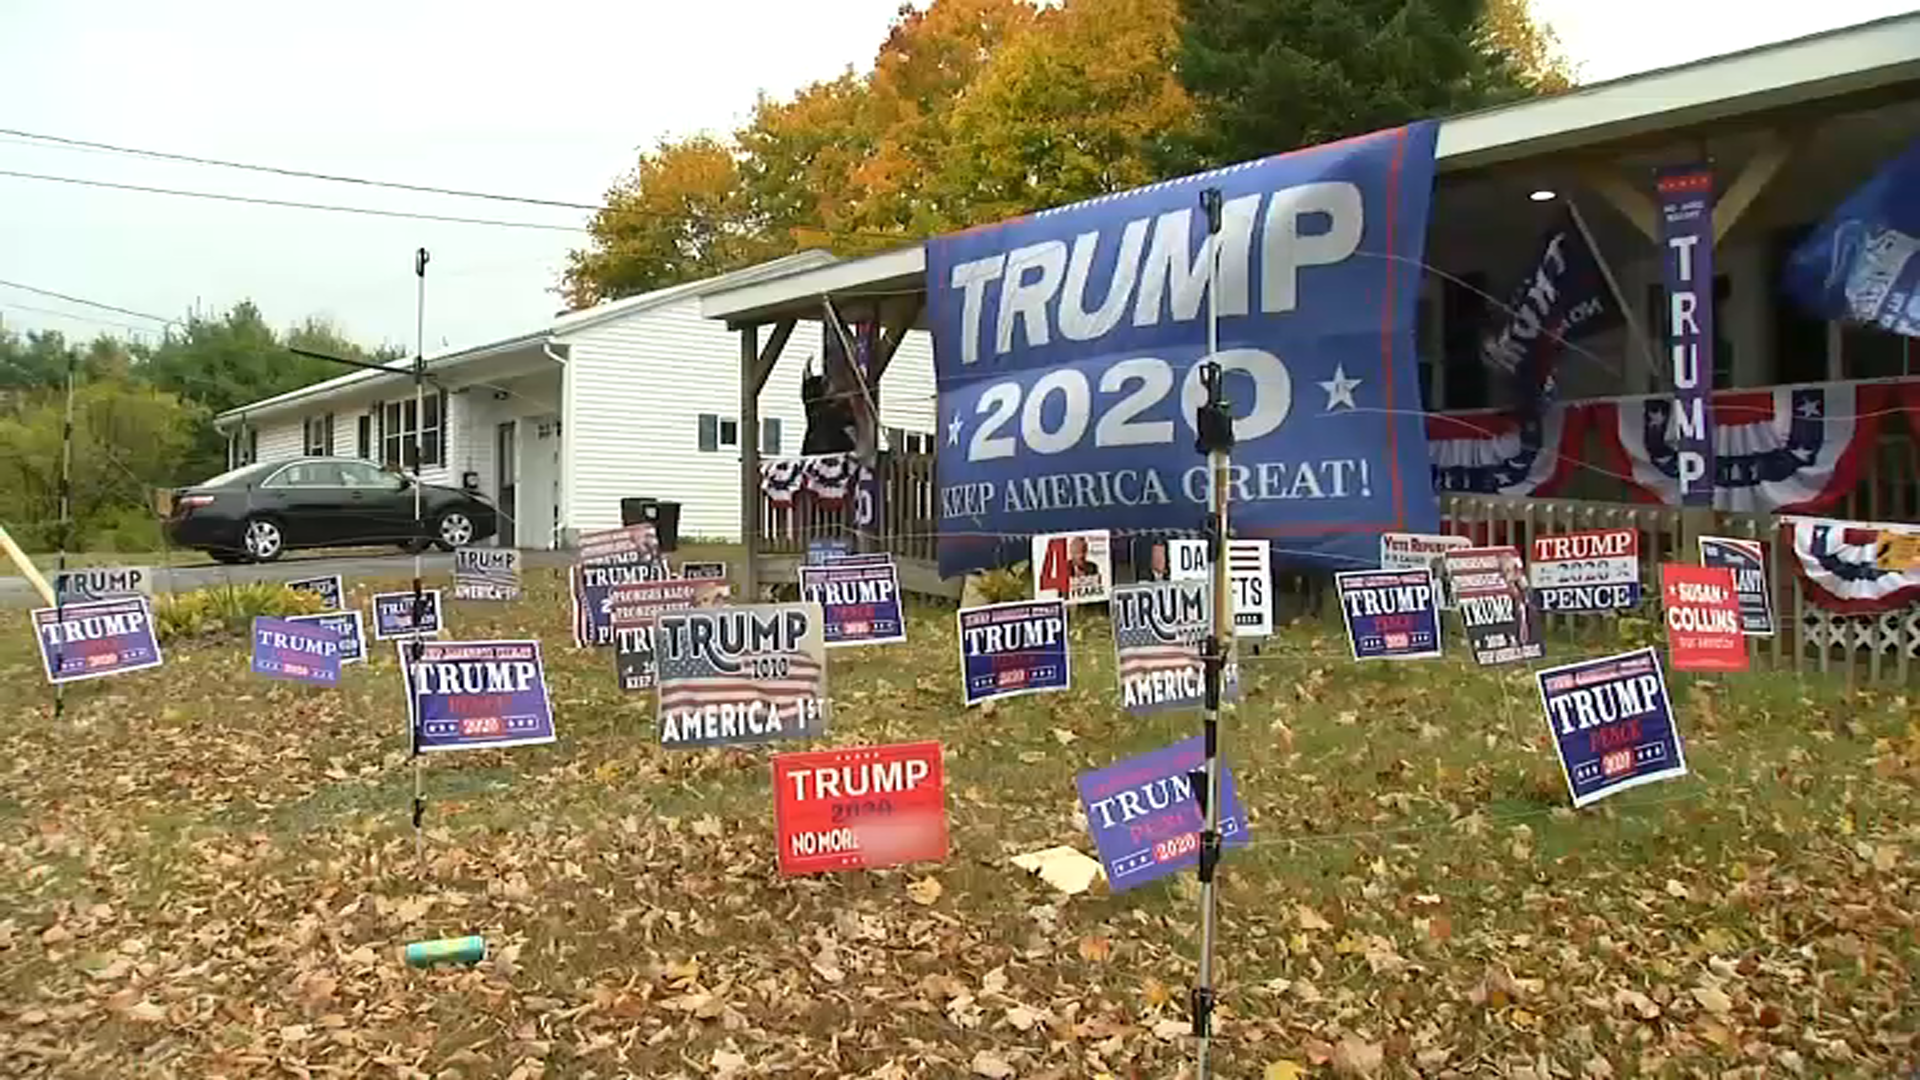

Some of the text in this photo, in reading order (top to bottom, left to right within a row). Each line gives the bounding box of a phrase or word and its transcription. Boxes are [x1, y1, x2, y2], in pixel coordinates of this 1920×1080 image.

[950, 181, 1364, 363] TRUMP
[1668, 235, 1705, 496] TRUMP
[967, 348, 1292, 461] 2020
[940, 459, 1373, 519] KEEP AMERICA GREAT!
[1535, 532, 1631, 560] TRUMP
[459, 551, 515, 575] TRUMP
[584, 565, 649, 587] TRUMP
[1040, 538, 1068, 593] 4
[59, 569, 142, 600] TRUMP
[806, 579, 893, 605] TRUMP
[1344, 585, 1430, 617] TRUMP
[1542, 585, 1631, 610] PENCE
[1679, 583, 1723, 603] SUSAN
[1114, 584, 1208, 643] TRUM
[1459, 594, 1515, 627] TRUMP
[1669, 606, 1738, 634] COLLINS
[42, 612, 145, 645] TRUMP
[257, 629, 337, 657] TRUMP
[660, 608, 809, 675] TRUMP
[965, 617, 1062, 657] TRUMP
[409, 662, 536, 694] TRUMP
[1124, 661, 1207, 708] AMERICA
[661, 697, 826, 743] AMERICA 1ST
[1550, 674, 1659, 735] TRUMP
[786, 759, 930, 802] TRUMP
[1089, 764, 1206, 829] TRUM
[791, 831, 817, 857] NO
[1155, 833, 1197, 862] 2020
